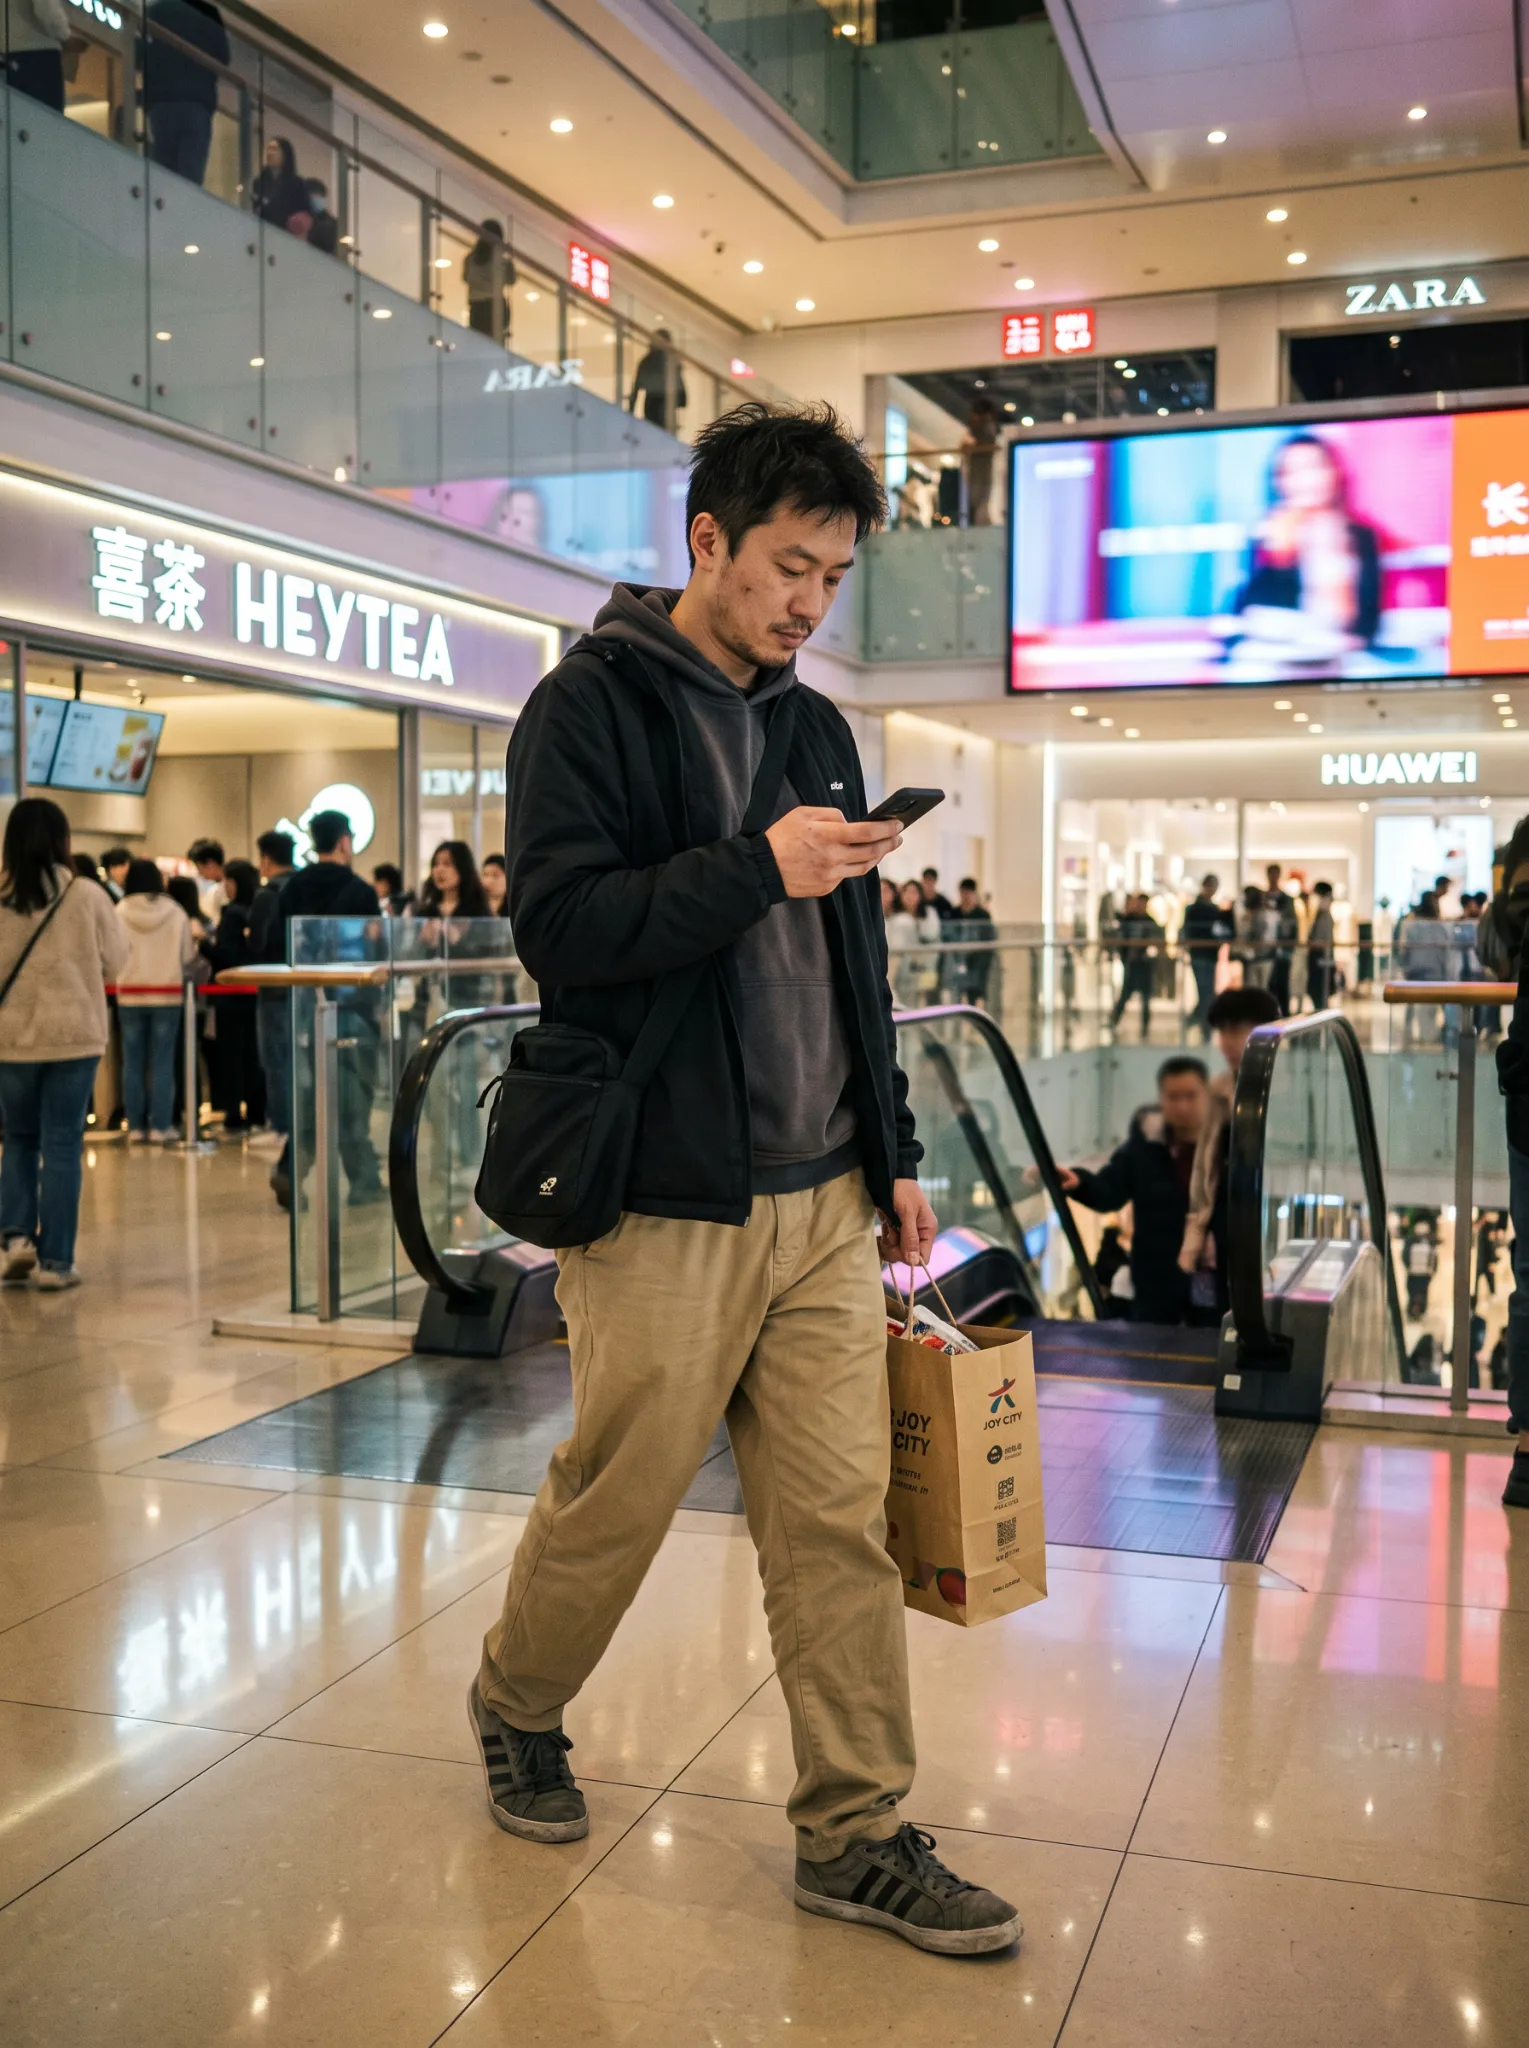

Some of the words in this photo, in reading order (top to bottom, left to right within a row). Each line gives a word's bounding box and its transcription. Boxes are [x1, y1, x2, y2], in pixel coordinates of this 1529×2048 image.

[1345, 277, 1486, 316] ZARA
[91, 526, 206, 632] 喜茶
[234, 561, 455, 687] HEYTEA
[1321, 751, 1477, 786] HUAWEI
[896, 1409, 931, 1433] JOY
[983, 1418, 1001, 1431] JOY
[1003, 1411, 1022, 1425] CITY
[893, 1431, 931, 1457] CITY
